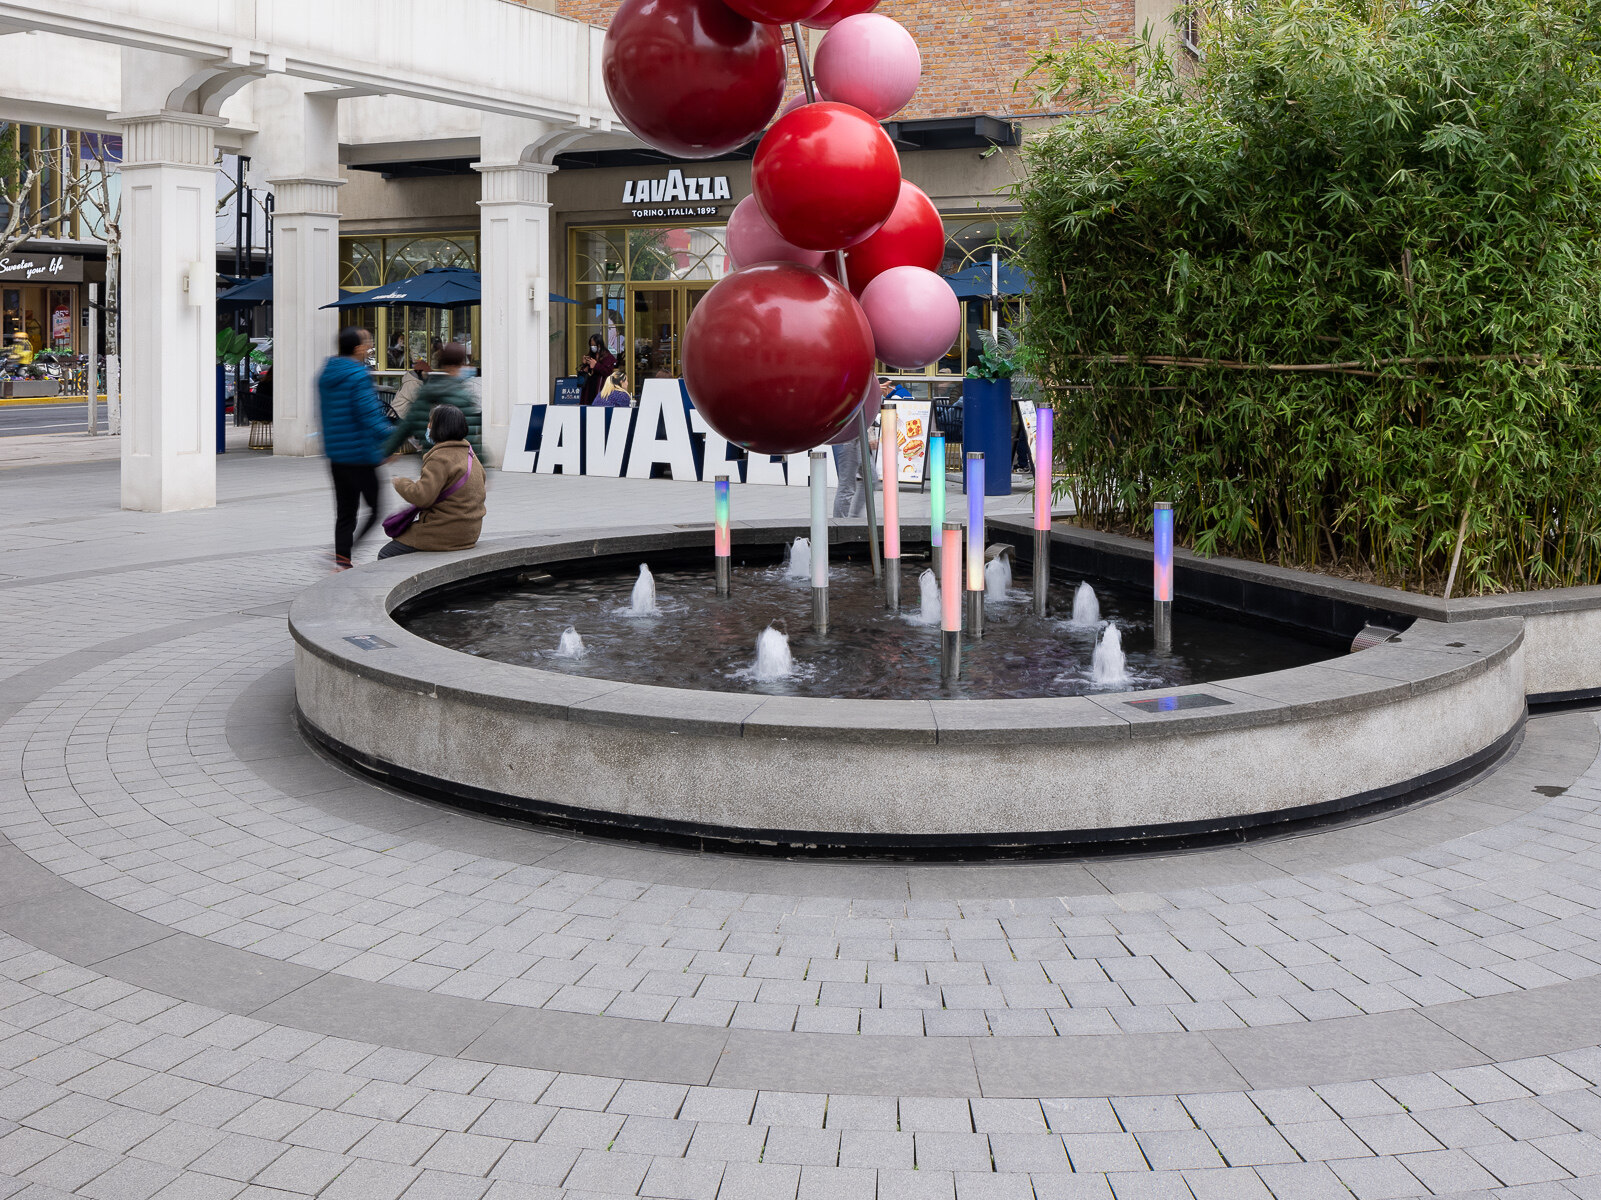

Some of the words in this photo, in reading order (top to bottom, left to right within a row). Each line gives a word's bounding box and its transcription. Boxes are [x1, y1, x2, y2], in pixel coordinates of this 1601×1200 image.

[622, 169, 731, 203] LAVAZZA
[697, 207, 716, 215] 1895
[0, 258, 33, 273] Sweeten
[26, 266, 46, 279] your
[49, 256, 64, 275] life
